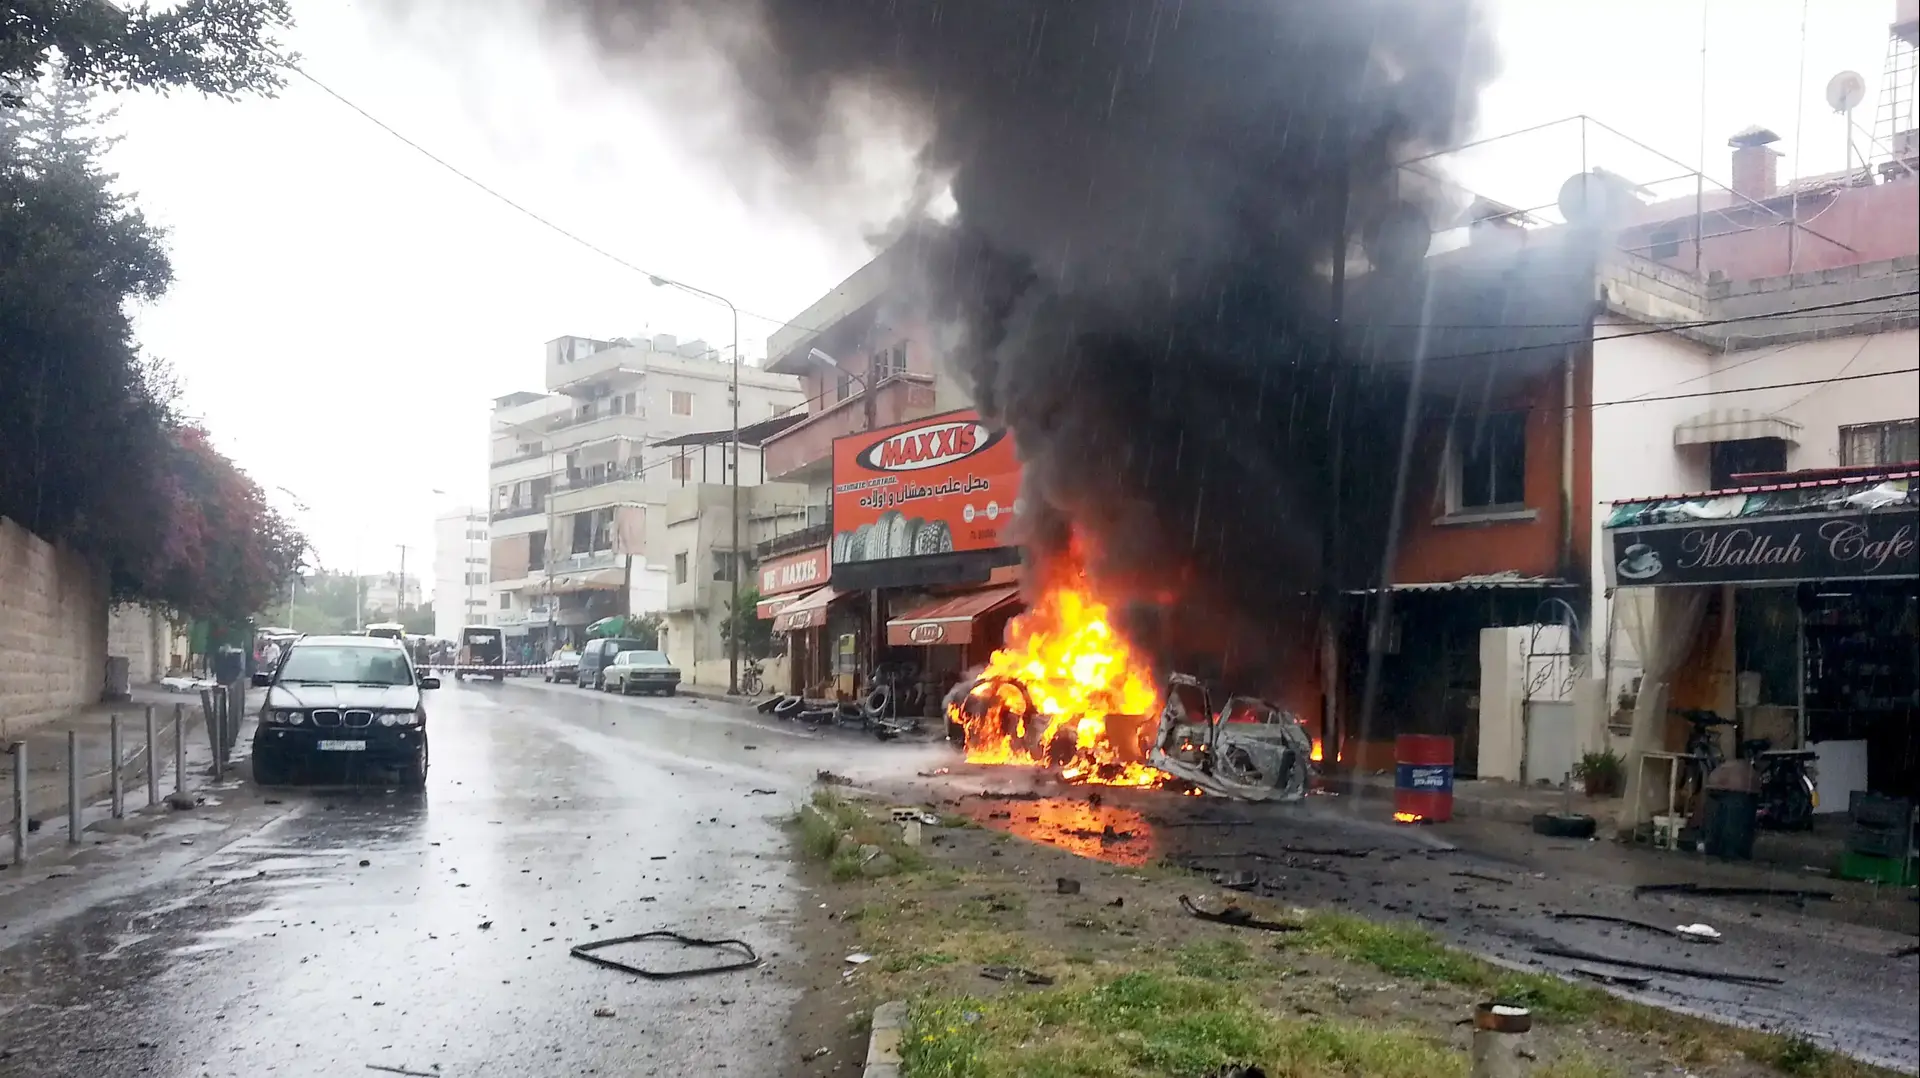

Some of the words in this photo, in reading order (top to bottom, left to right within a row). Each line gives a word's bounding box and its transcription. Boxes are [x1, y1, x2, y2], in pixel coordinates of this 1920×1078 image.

[880, 424, 976, 467] MAXXIS
[963, 474, 989, 494] محل
[1677, 528, 1807, 568] Mallah
[1818, 520, 1916, 572] Cafe
